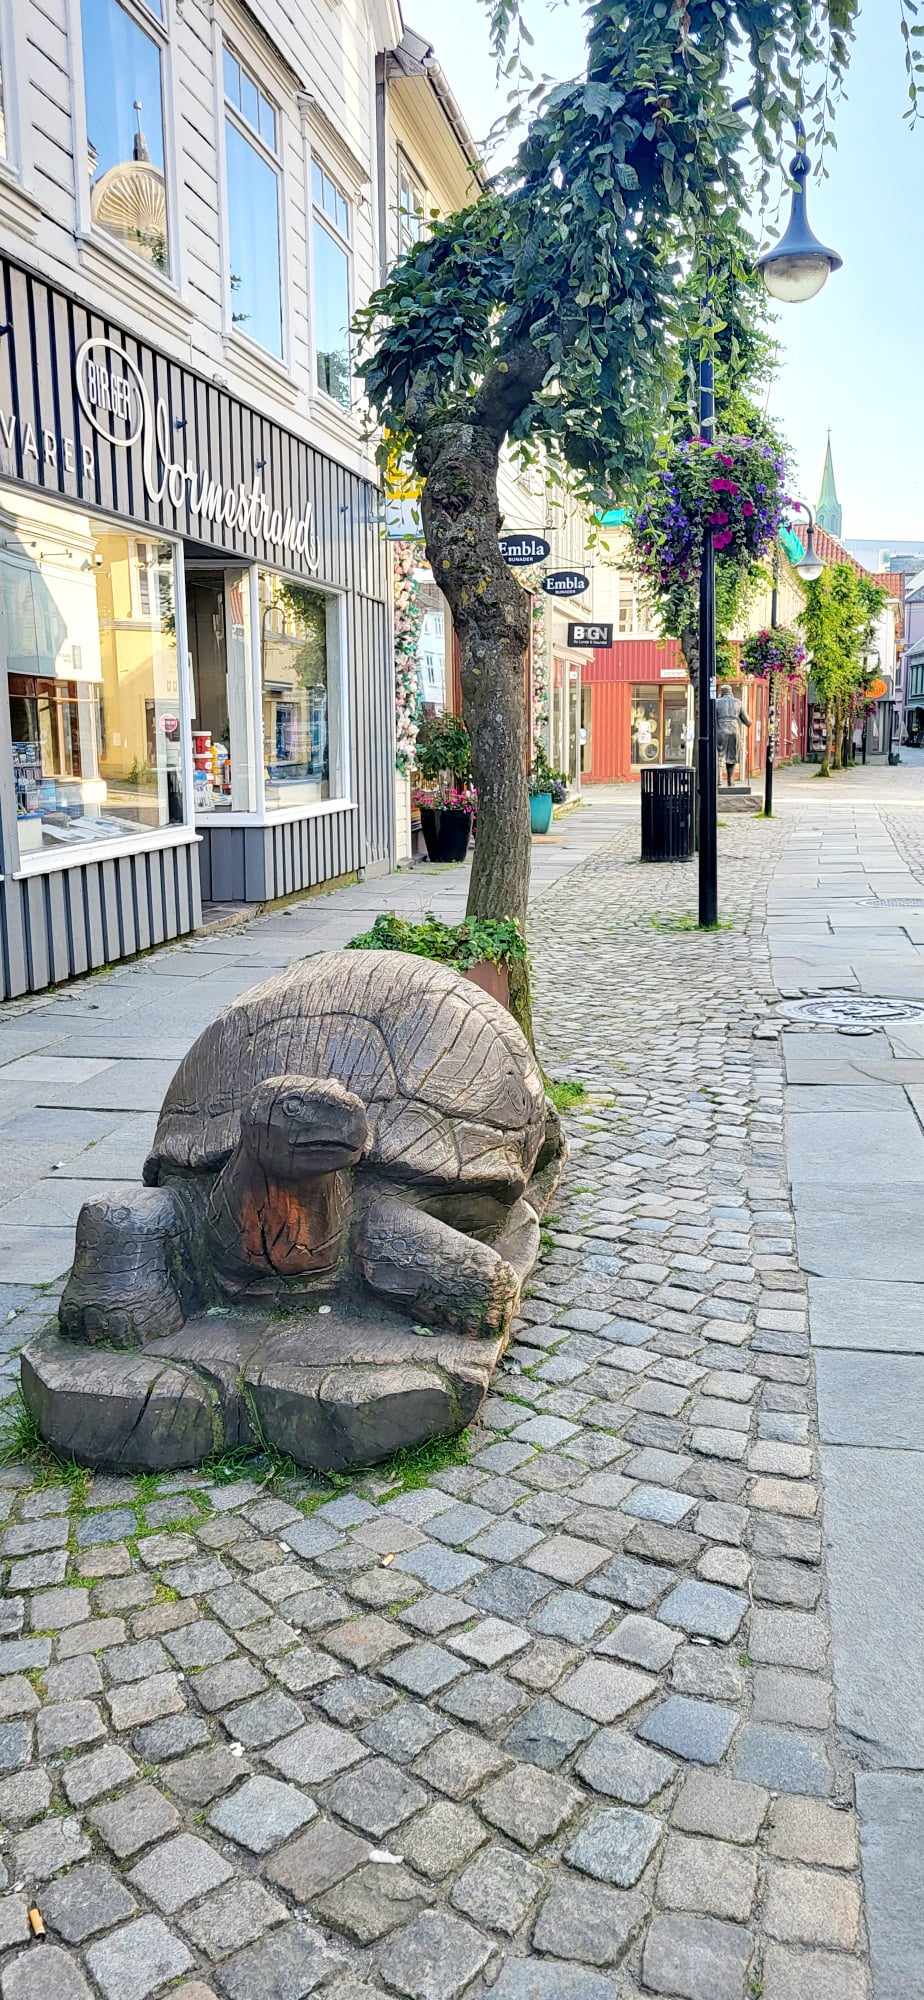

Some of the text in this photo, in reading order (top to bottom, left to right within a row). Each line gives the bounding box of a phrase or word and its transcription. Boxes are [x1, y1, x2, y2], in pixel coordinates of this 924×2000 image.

[87, 359, 131, 421] BIRGER
[0, 410, 95, 480] VARER
[141, 386, 320, 571] Vormestrand
[498, 541, 545, 556] Embla
[546, 576, 585, 590] Embla
